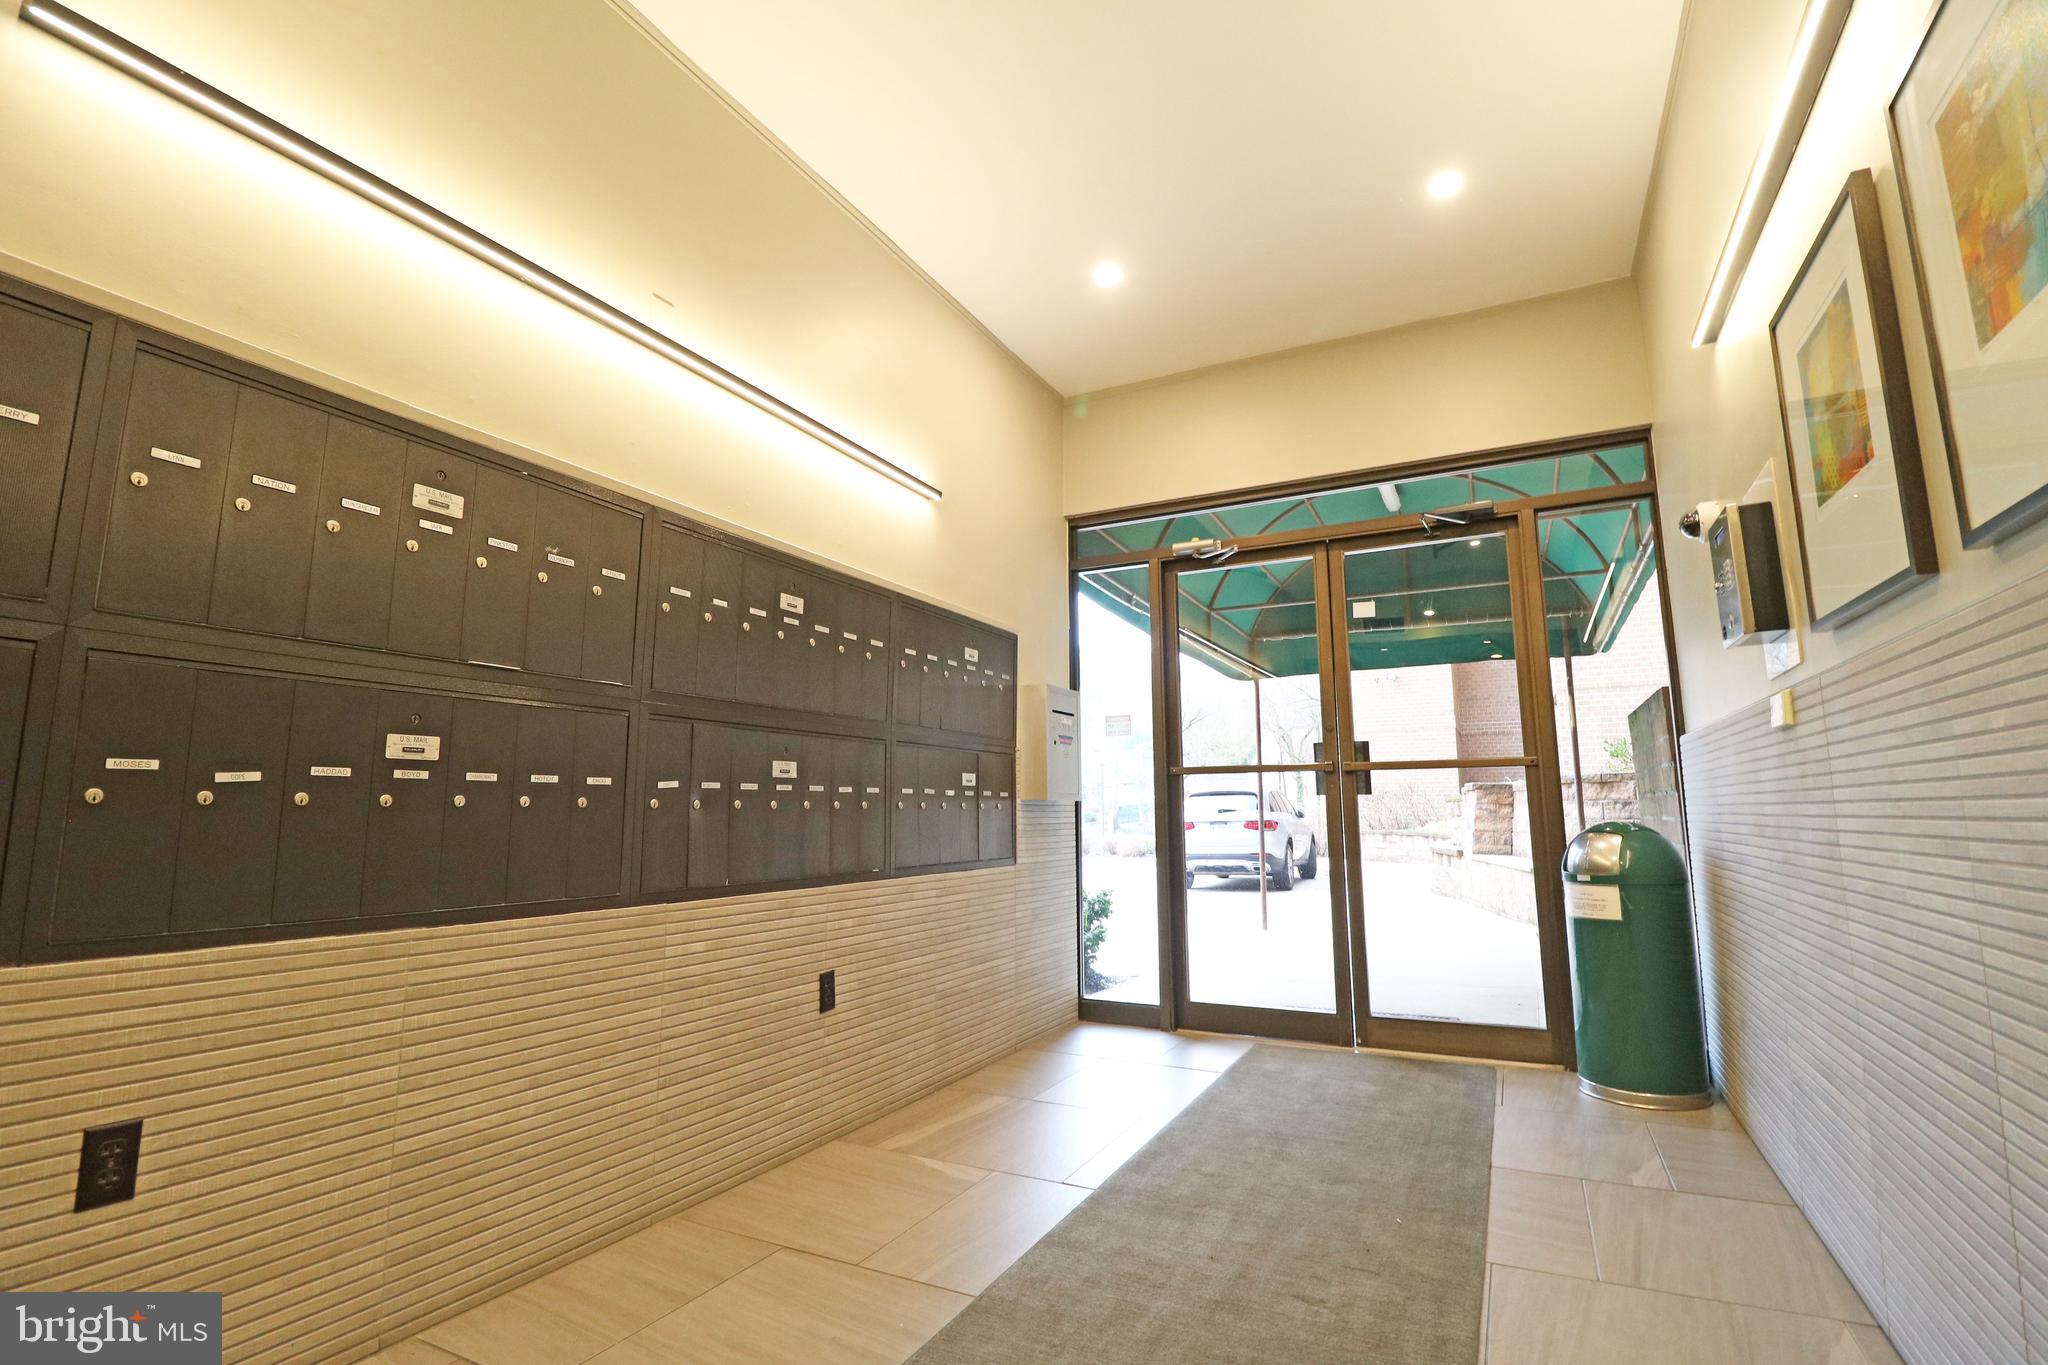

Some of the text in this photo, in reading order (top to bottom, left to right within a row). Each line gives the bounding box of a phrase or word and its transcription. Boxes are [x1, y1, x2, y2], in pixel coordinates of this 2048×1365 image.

[167, 453, 185, 463] LYNN
[256, 476, 291, 491] NATION
[439, 491, 453, 501] MAIL
[399, 735, 429, 744] U.S. MAIL
[112, 760, 152, 769] MOSES
[313, 767, 349, 776] HADDAD
[230, 773, 246, 781] COPE
